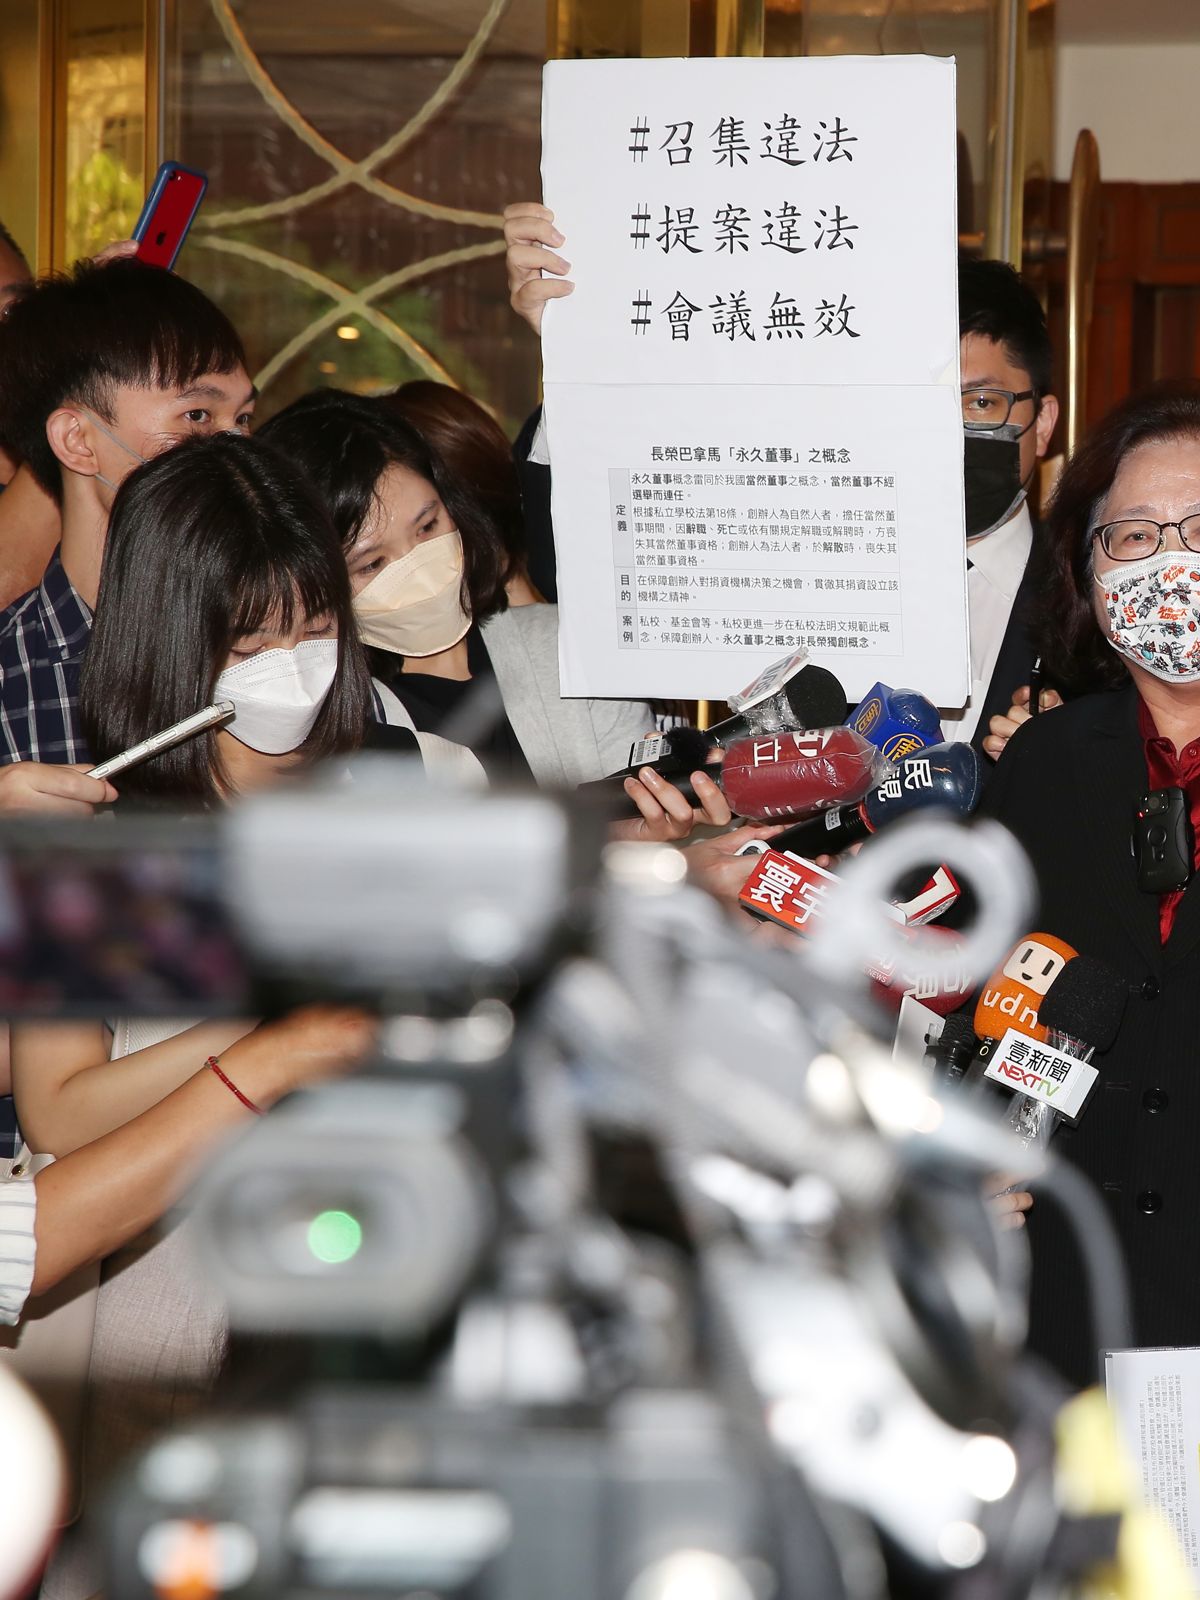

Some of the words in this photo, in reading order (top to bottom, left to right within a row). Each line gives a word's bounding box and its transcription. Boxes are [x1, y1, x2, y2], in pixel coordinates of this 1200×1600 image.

[628, 112, 858, 168] #召集違法
[630, 201, 859, 255] #提案違法
[631, 289, 861, 342] #會議無效
[983, 988, 1039, 1030] udn
[1005, 1039, 1072, 1084] 壹新聞
